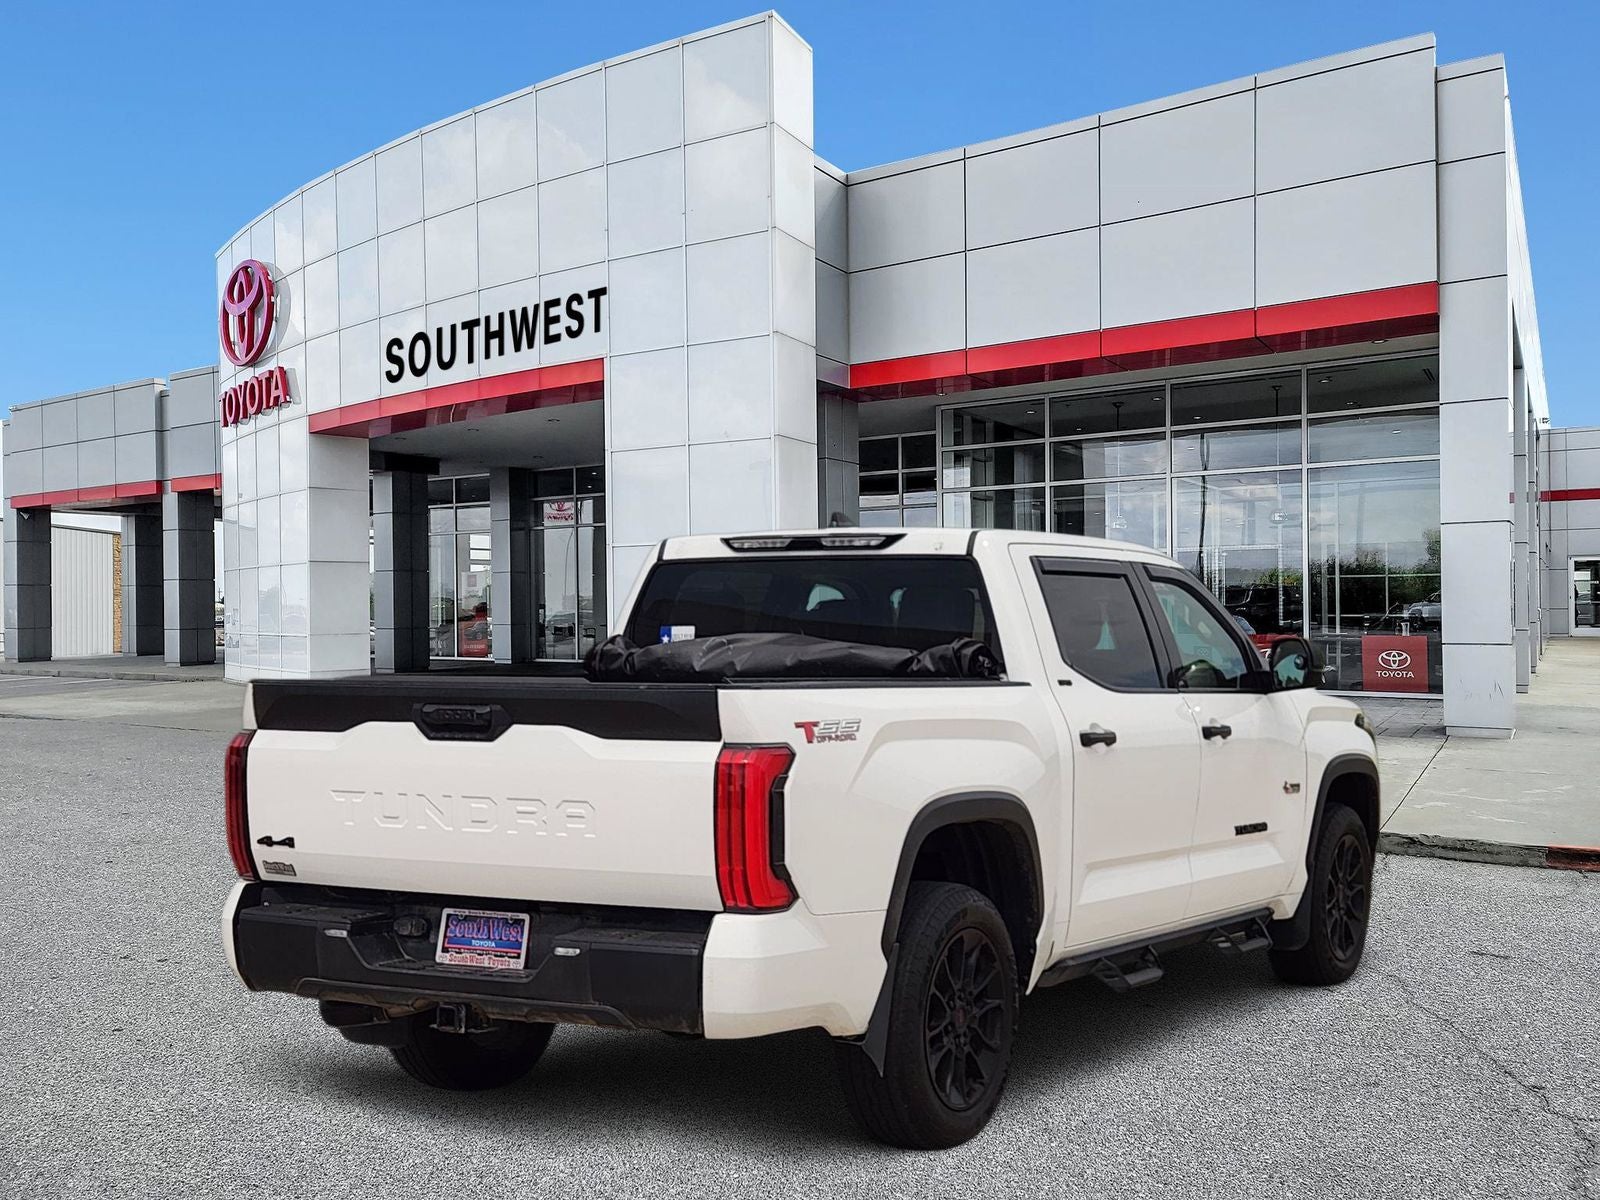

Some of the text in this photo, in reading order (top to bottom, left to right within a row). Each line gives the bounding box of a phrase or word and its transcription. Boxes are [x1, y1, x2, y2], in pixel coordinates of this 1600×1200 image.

[385, 286, 607, 384] SOUTHWEST
[219, 366, 291, 428] TOYOTA
[1376, 670, 1415, 678] TOYOTA
[330, 790, 597, 838] TUNDRA
[471, 939, 496, 948] TOYOTA
